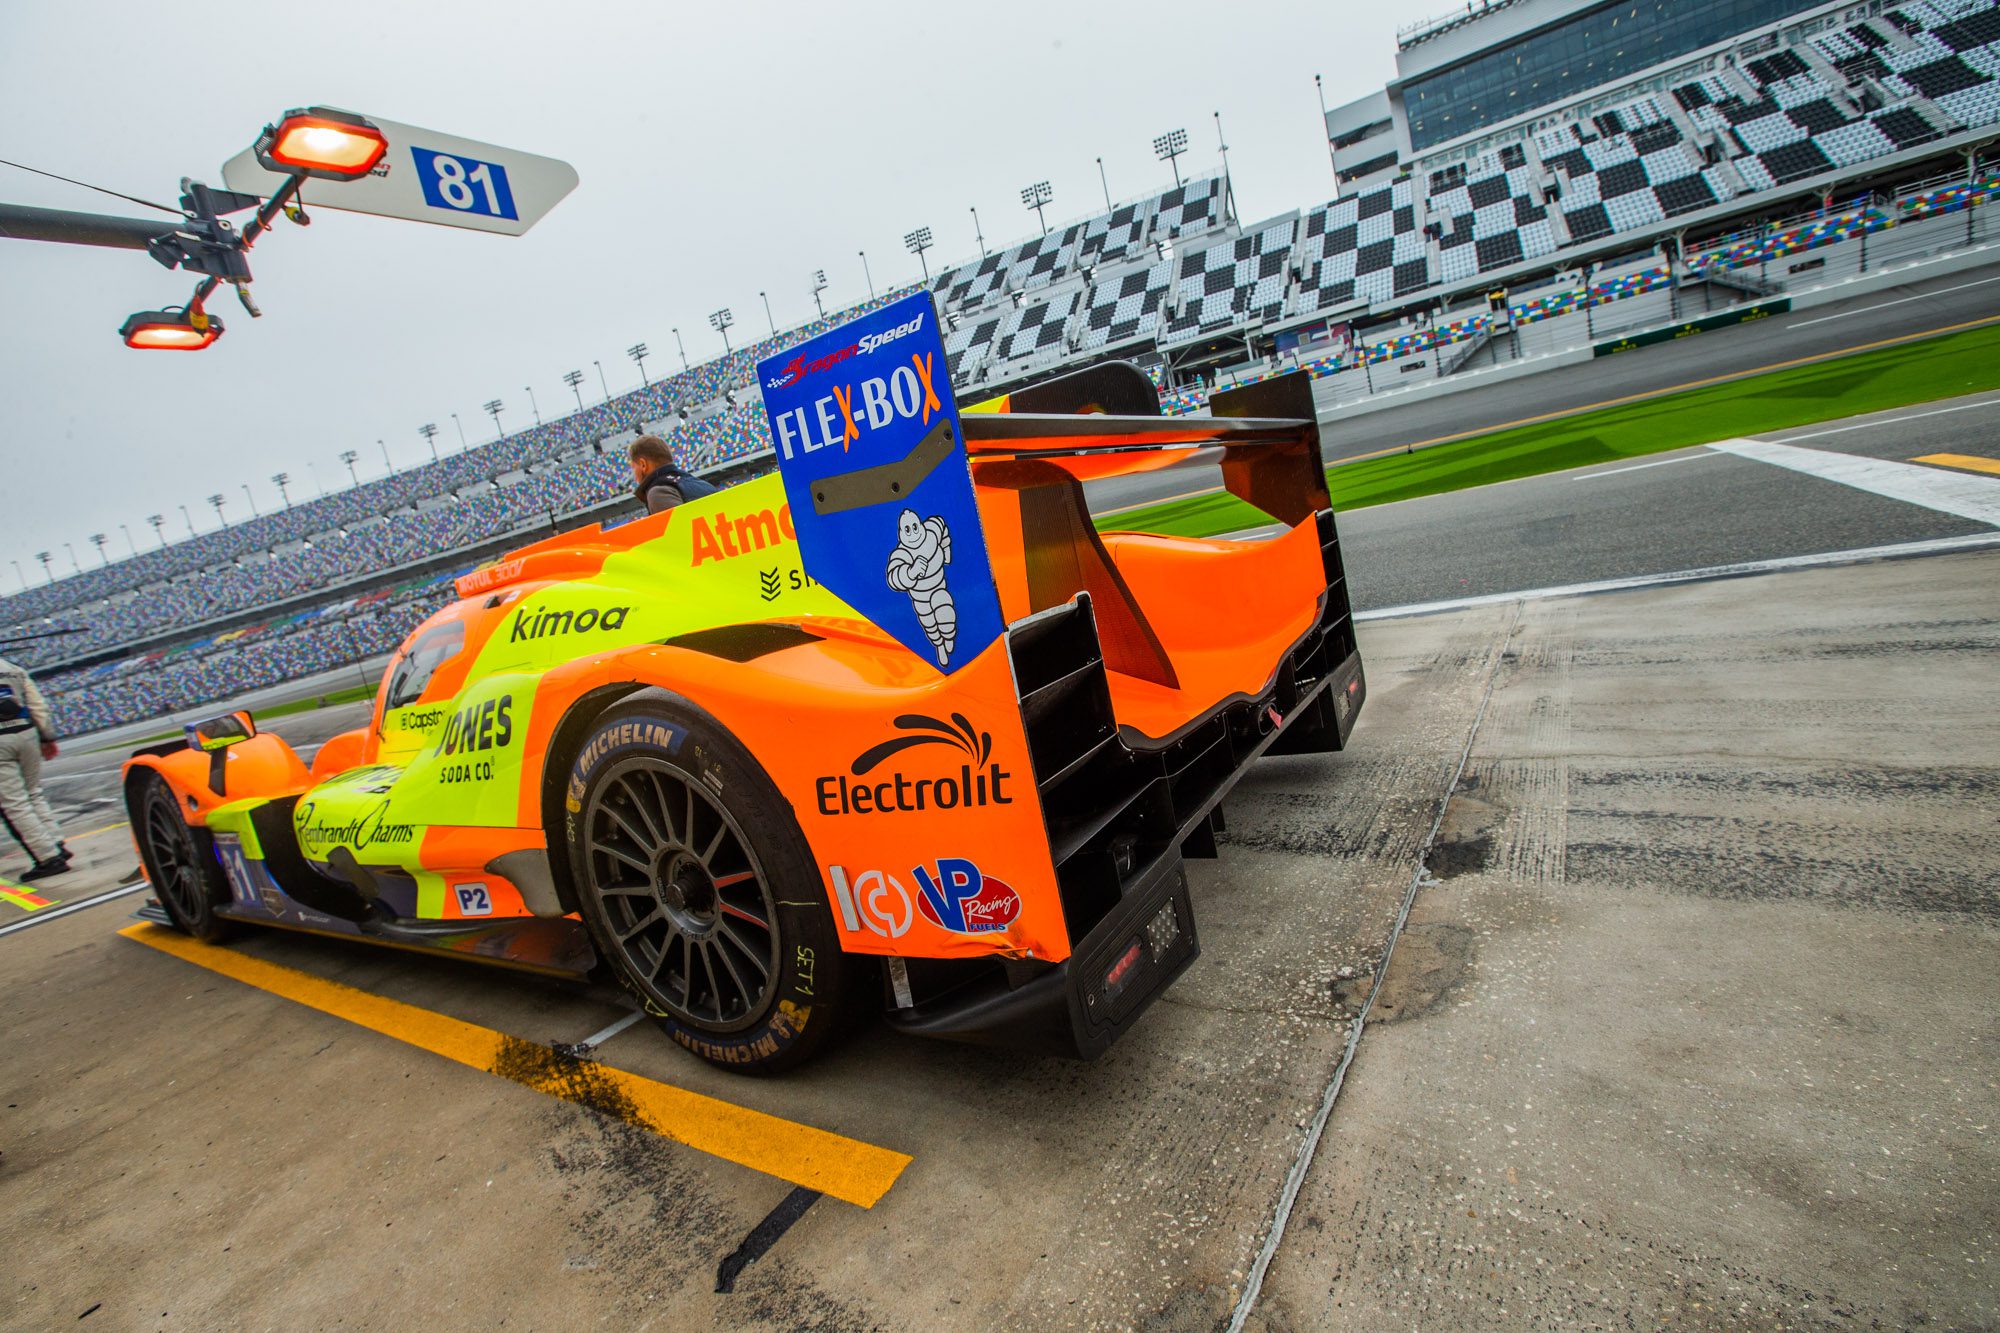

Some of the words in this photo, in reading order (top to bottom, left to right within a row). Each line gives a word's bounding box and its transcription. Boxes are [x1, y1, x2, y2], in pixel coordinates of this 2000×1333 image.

[433, 155, 501, 215] 81
[776, 352, 941, 460] FLEX-BOX
[510, 605, 630, 644] kimoa
[434, 694, 512, 758] JONES
[580, 723, 674, 778] MICHELIN
[440, 764, 471, 784] SODA
[815, 763, 1013, 816] Electrolit
[459, 888, 489, 910] P2
[912, 858, 982, 932] VP
[965, 895, 1019, 923] Racing
[970, 923, 1006, 931] FUELS
[673, 1029, 779, 1064] MICHELIN
